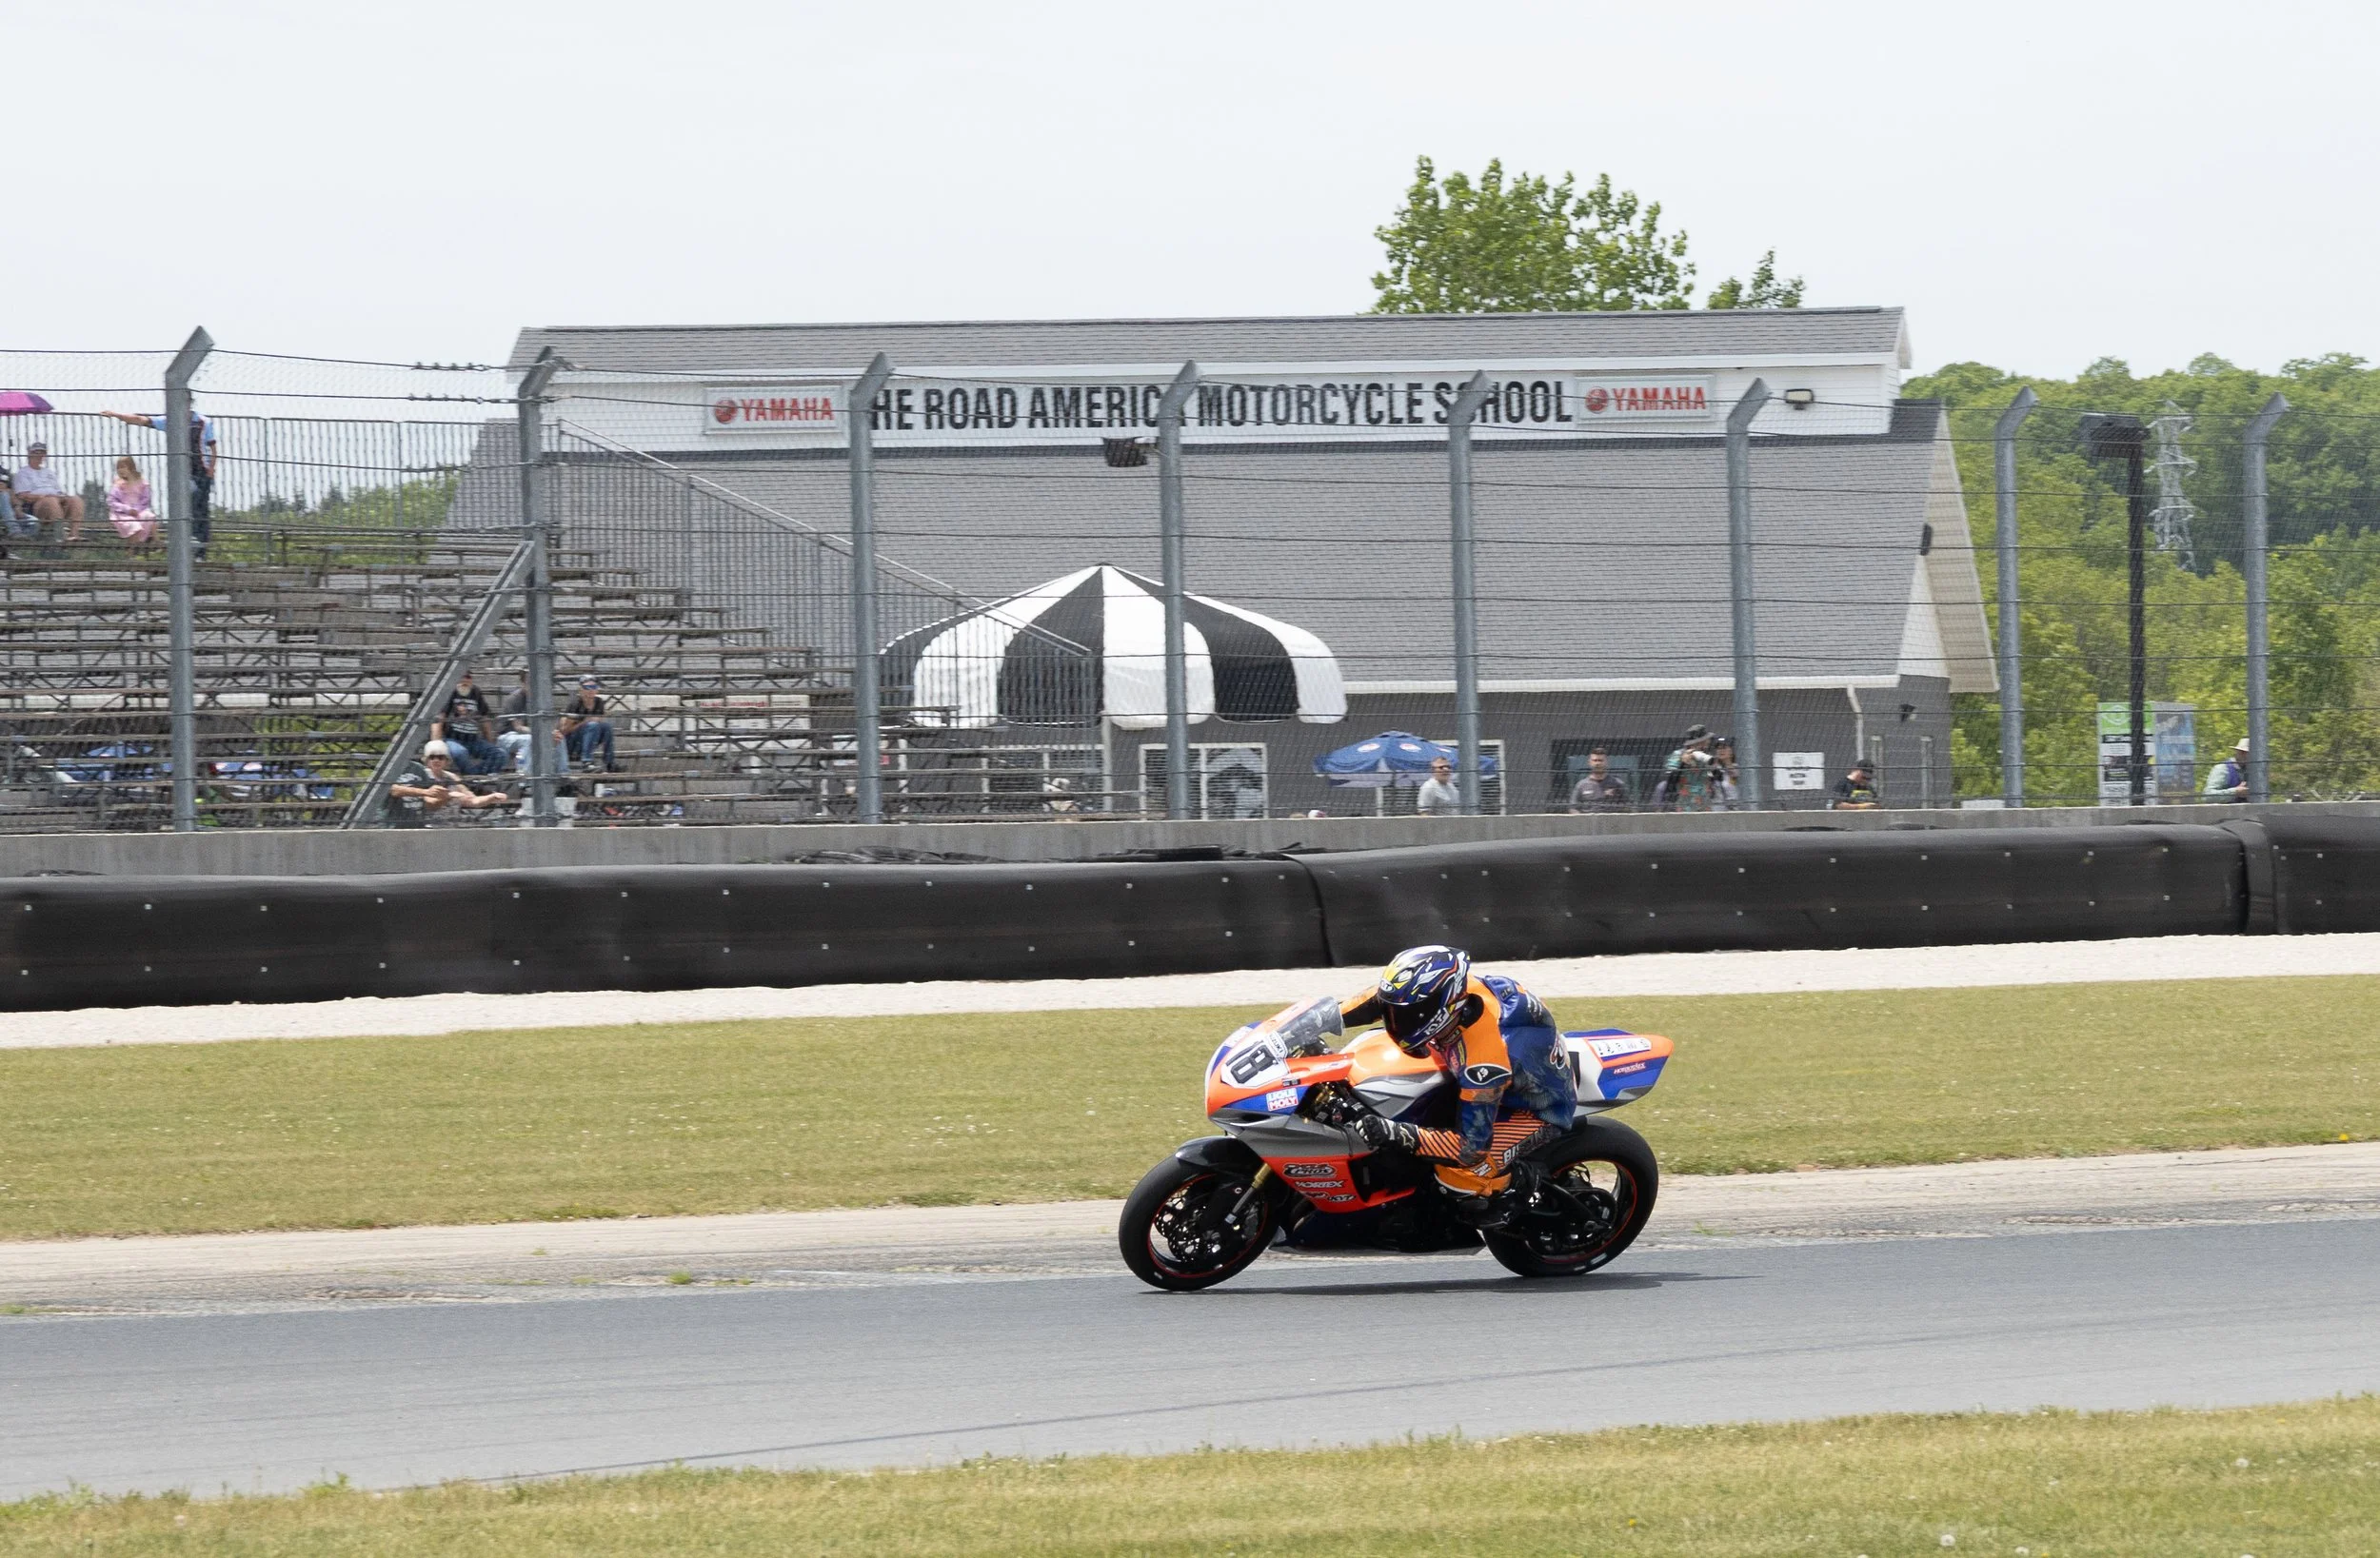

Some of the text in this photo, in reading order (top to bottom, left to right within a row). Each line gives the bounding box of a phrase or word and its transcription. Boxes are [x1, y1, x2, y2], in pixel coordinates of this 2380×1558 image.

[742, 397, 835, 422] YAMAHA
[871, 388, 914, 430] HE
[924, 387, 1017, 430] ROAD
[1028, 385, 1186, 428] AMERIC
[1198, 382, 1424, 427] MOTORCYCLE
[1613, 386, 1707, 411] YAMAHA
[1226, 1040, 1279, 1084] 18
[1267, 1089, 1297, 1101] LIQUI
[1268, 1096, 1299, 1111] MOLY
[1295, 1180, 1344, 1189] VORTEX
